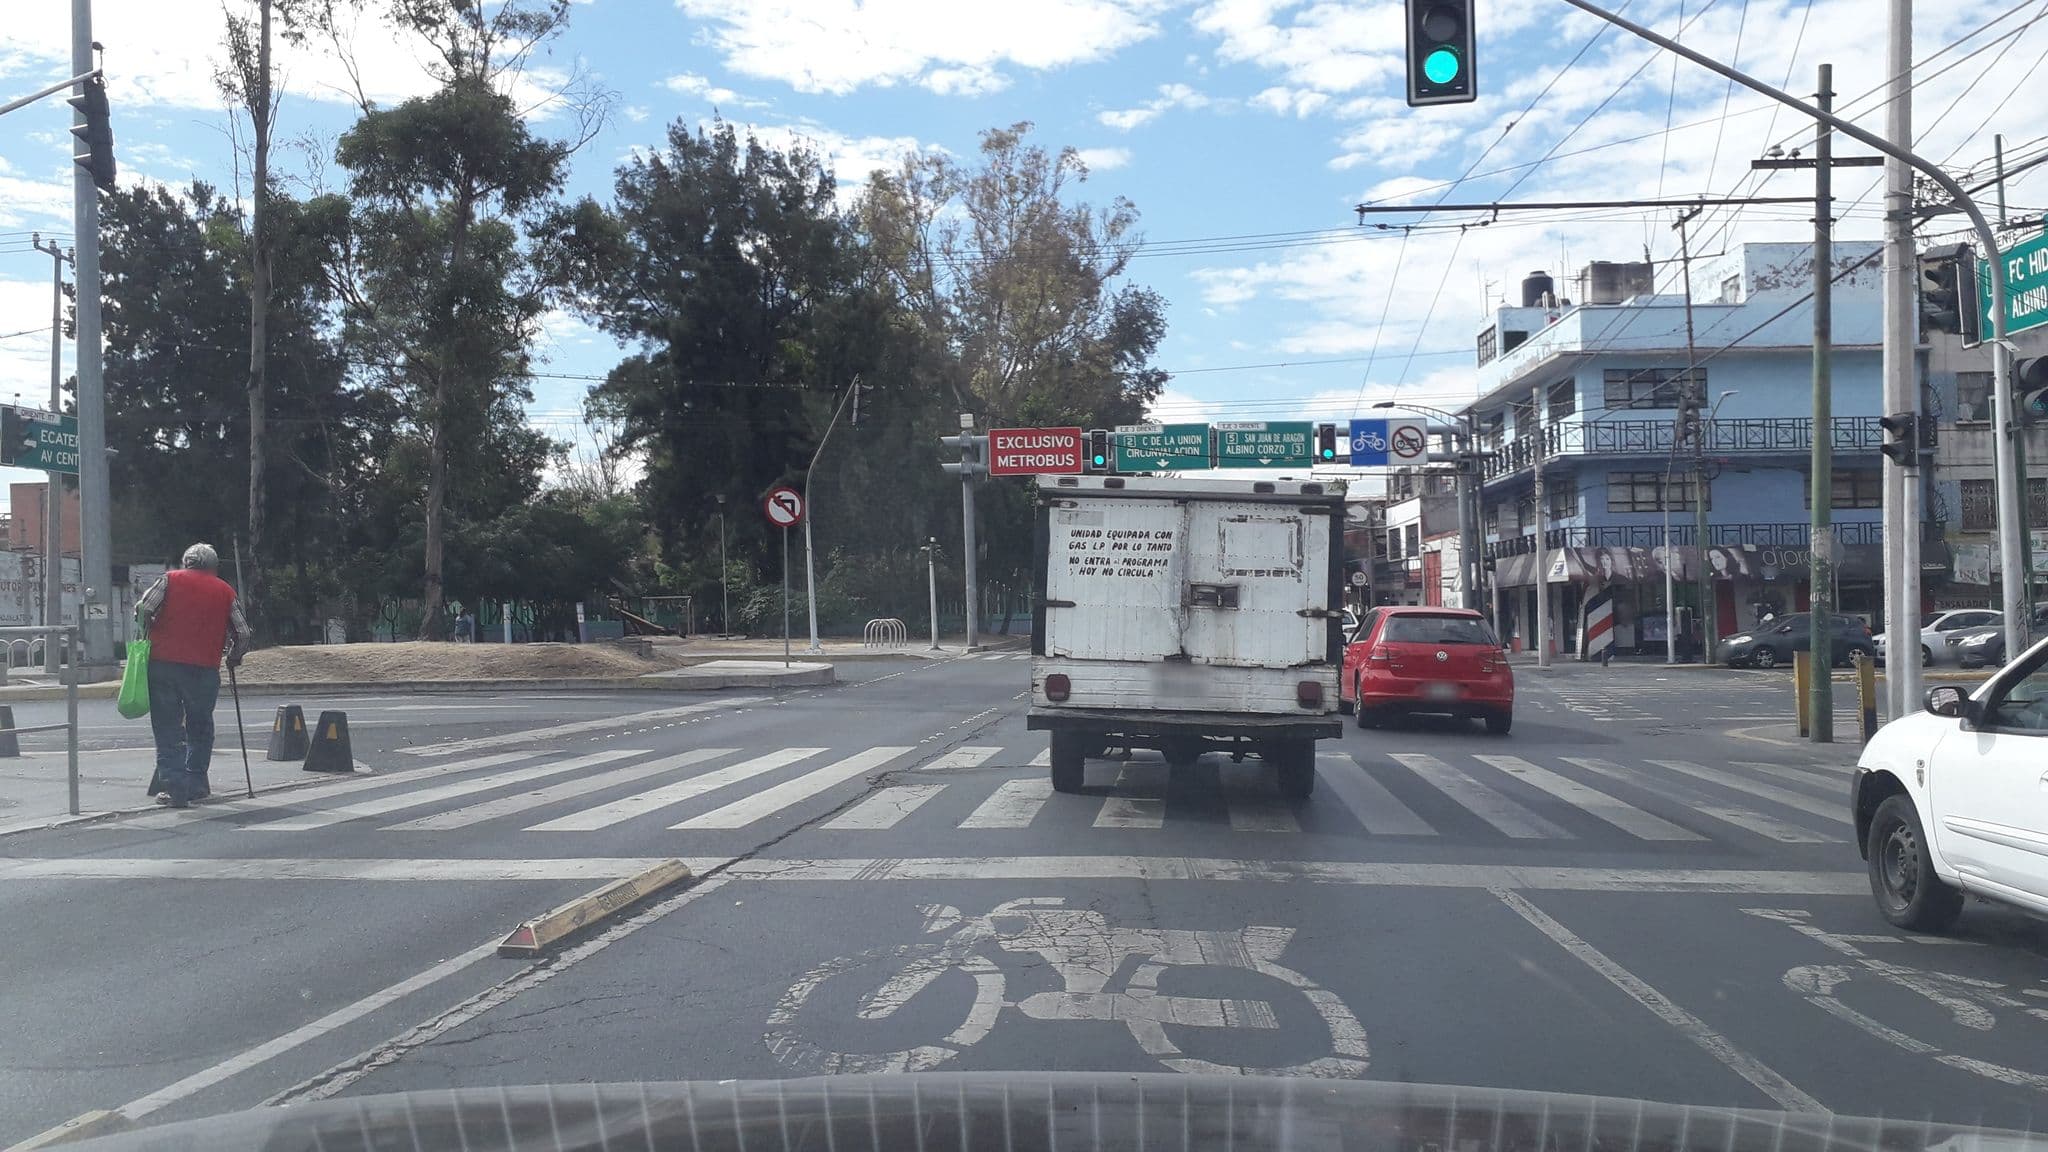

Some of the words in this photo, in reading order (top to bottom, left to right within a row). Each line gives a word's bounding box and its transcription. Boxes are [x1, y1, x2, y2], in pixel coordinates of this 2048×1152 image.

[2008, 256, 2025, 284] FC
[2012, 285, 2048, 319] ALBINO
[997, 436, 1074, 449] EXCLUSIVO
[1127, 438, 1134, 446] 2
[1142, 437, 1149, 446] C
[1151, 436, 1161, 446] DE
[1164, 436, 1175, 446] LA
[1177, 435, 1202, 445] UNION
[1229, 434, 1236, 442] 5
[1244, 433, 1256, 443] SAN
[1258, 433, 1272, 442] JUAN
[1273, 433, 1281, 442] DE
[1126, 447, 1200, 457] CIRCUNVALACION
[1226, 445, 1255, 454] ALBINO
[1257, 444, 1285, 454] CORZO
[41, 449, 53, 464] AV
[56, 451, 79, 466] CENT
[997, 453, 1075, 468] METROBUS
[1071, 529, 1102, 539] UNIDAD
[1106, 529, 1150, 540] EQUIPADA
[1154, 531, 1173, 540] CON
[1069, 541, 1087, 550] GAS
[1111, 542, 1128, 551] POR
[1132, 543, 1142, 551] LO
[1147, 542, 1172, 551] TANTO
[1069, 556, 1080, 565] NO
[1084, 556, 1111, 565] ENTRA
[1121, 558, 1169, 567] PROGRAMA
[1102, 567, 1114, 576] NO
[1117, 568, 1154, 577] CIRCULA
